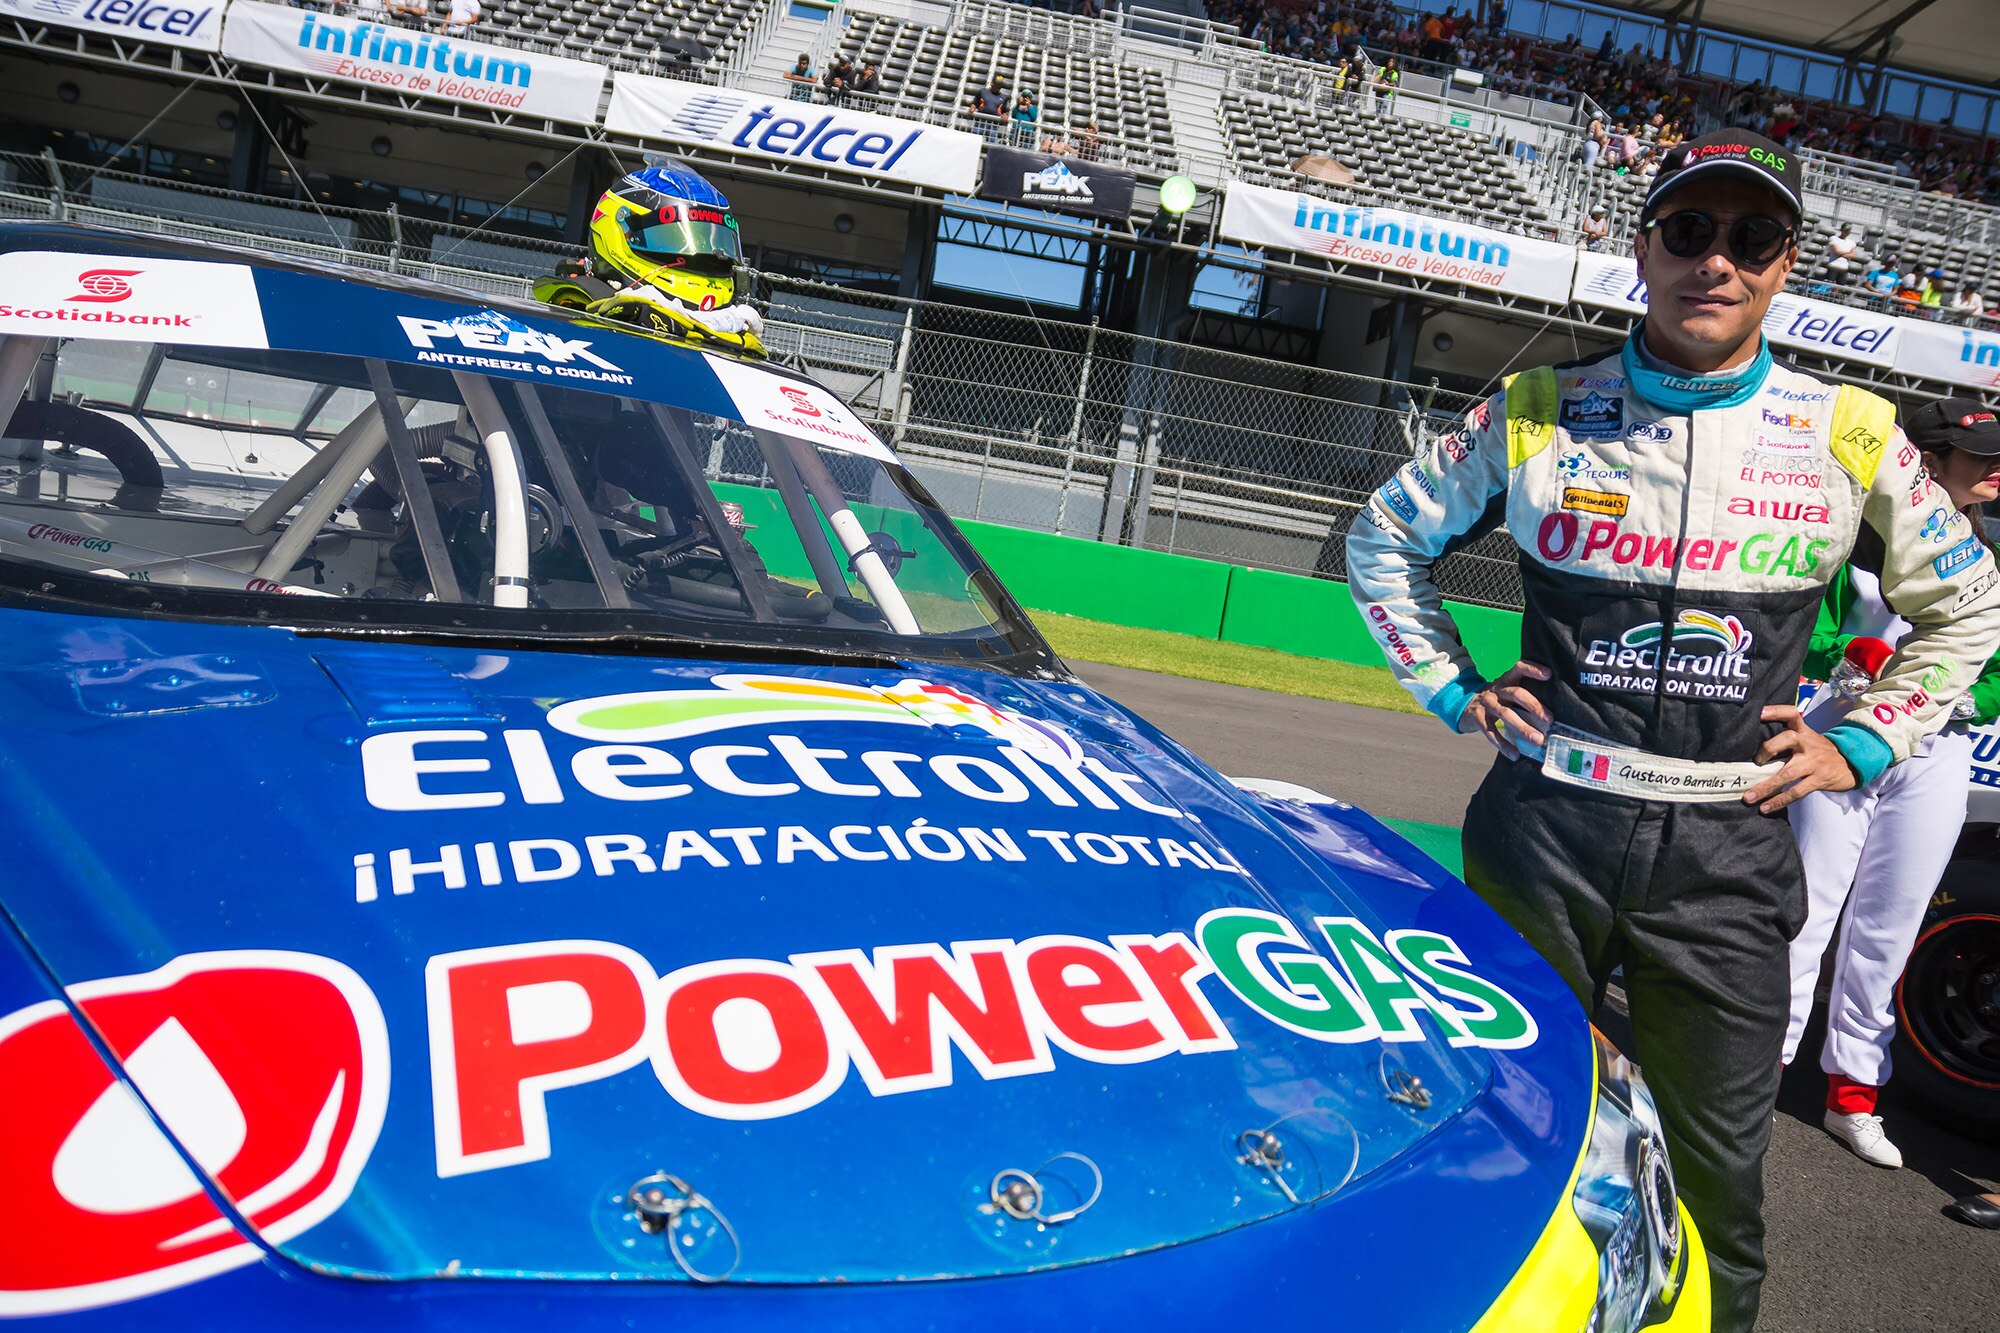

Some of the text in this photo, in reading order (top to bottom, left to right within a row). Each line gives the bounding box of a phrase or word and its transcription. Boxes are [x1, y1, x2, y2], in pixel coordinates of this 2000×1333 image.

[84, 0, 213, 37] telcel
[298, 13, 532, 88] infinitum
[336, 59, 527, 109] Exceso de Velocidad
[732, 105, 925, 171] telcel
[1700, 143, 1787, 173] PowerGAS
[1023, 171, 1094, 196] PEAK
[1294, 195, 1511, 268] infinitum
[1329, 239, 1506, 288] Exceso de Velocidad
[397, 313, 625, 373] PEAK
[1787, 308, 1895, 354] telcel
[416, 350, 634, 386] ANTIFREEZE COOLANT
[1567, 399, 1617, 417] PEAK
[1782, 390, 1831, 402] telcel
[764, 409, 872, 447] Scotiabank
[1511, 415, 1545, 437] K1
[1762, 407, 1813, 428] FedEx
[1766, 439, 1812, 450] Scotiabank
[1842, 427, 1882, 455] K1
[1408, 460, 1437, 499] TEQUIS
[1585, 469, 1630, 480] TEQUIS
[1740, 466, 1756, 483] EL
[1741, 450, 1824, 473] SEGUROS
[1727, 496, 1830, 525] aiwa
[43, 526, 118, 554] PowerGAS
[1582, 519, 1830, 579] PowerGAS
[361, 729, 1184, 820] Electrolit
[1619, 765, 1681, 787] Gustavo
[1682, 775, 1726, 788] Barrales
[353, 817, 1028, 904] ¡HIDRATACIÓN
[425, 906, 1540, 1179] PowerGAS
